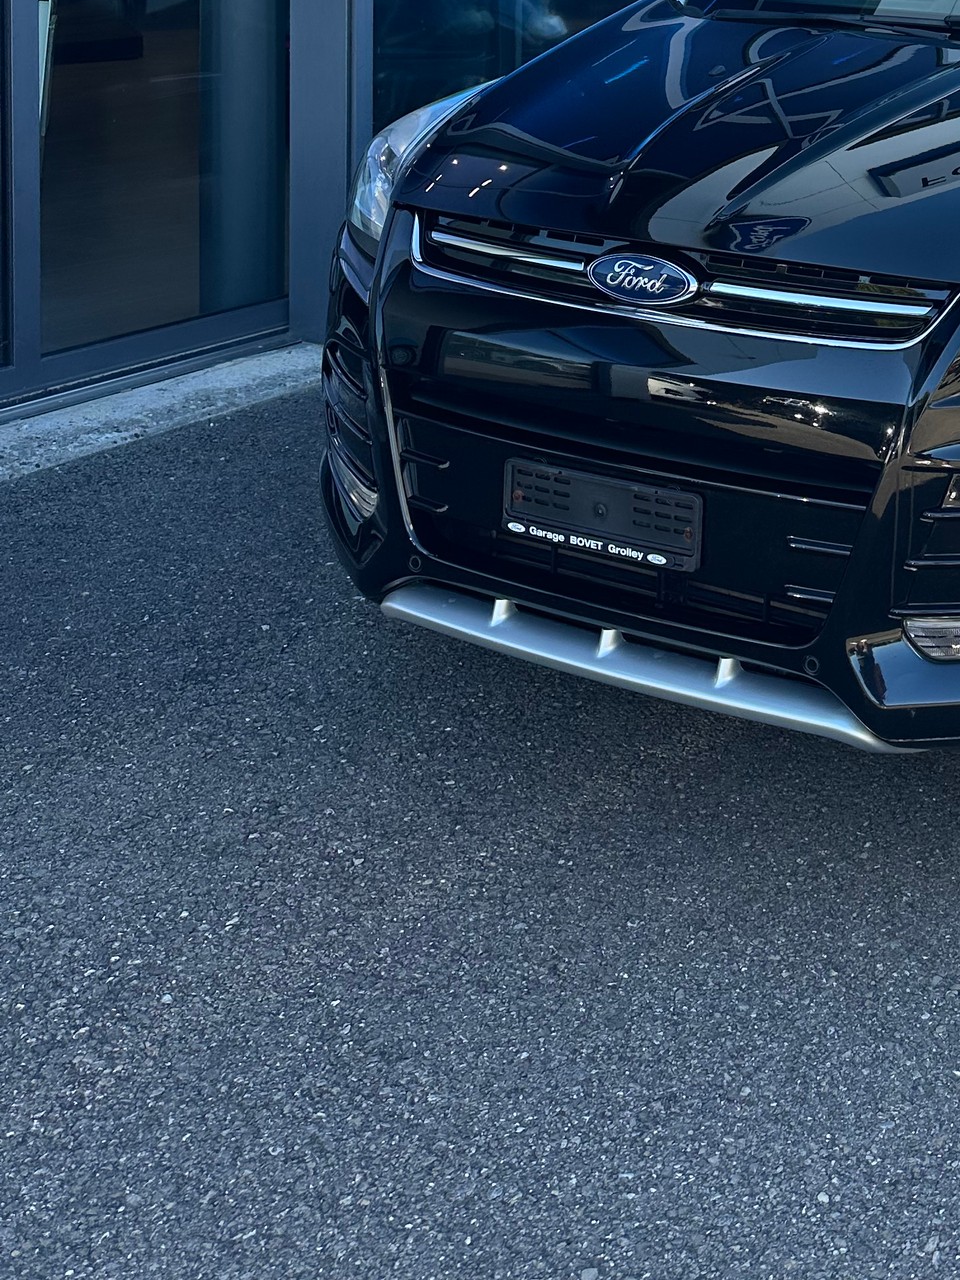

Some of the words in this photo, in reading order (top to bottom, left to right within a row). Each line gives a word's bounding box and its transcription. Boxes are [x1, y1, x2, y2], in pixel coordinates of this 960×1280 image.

[606, 260, 668, 294] Ford
[529, 526, 565, 542] Garage
[569, 535, 603, 551] BOVET
[608, 544, 644, 561] Grolley
